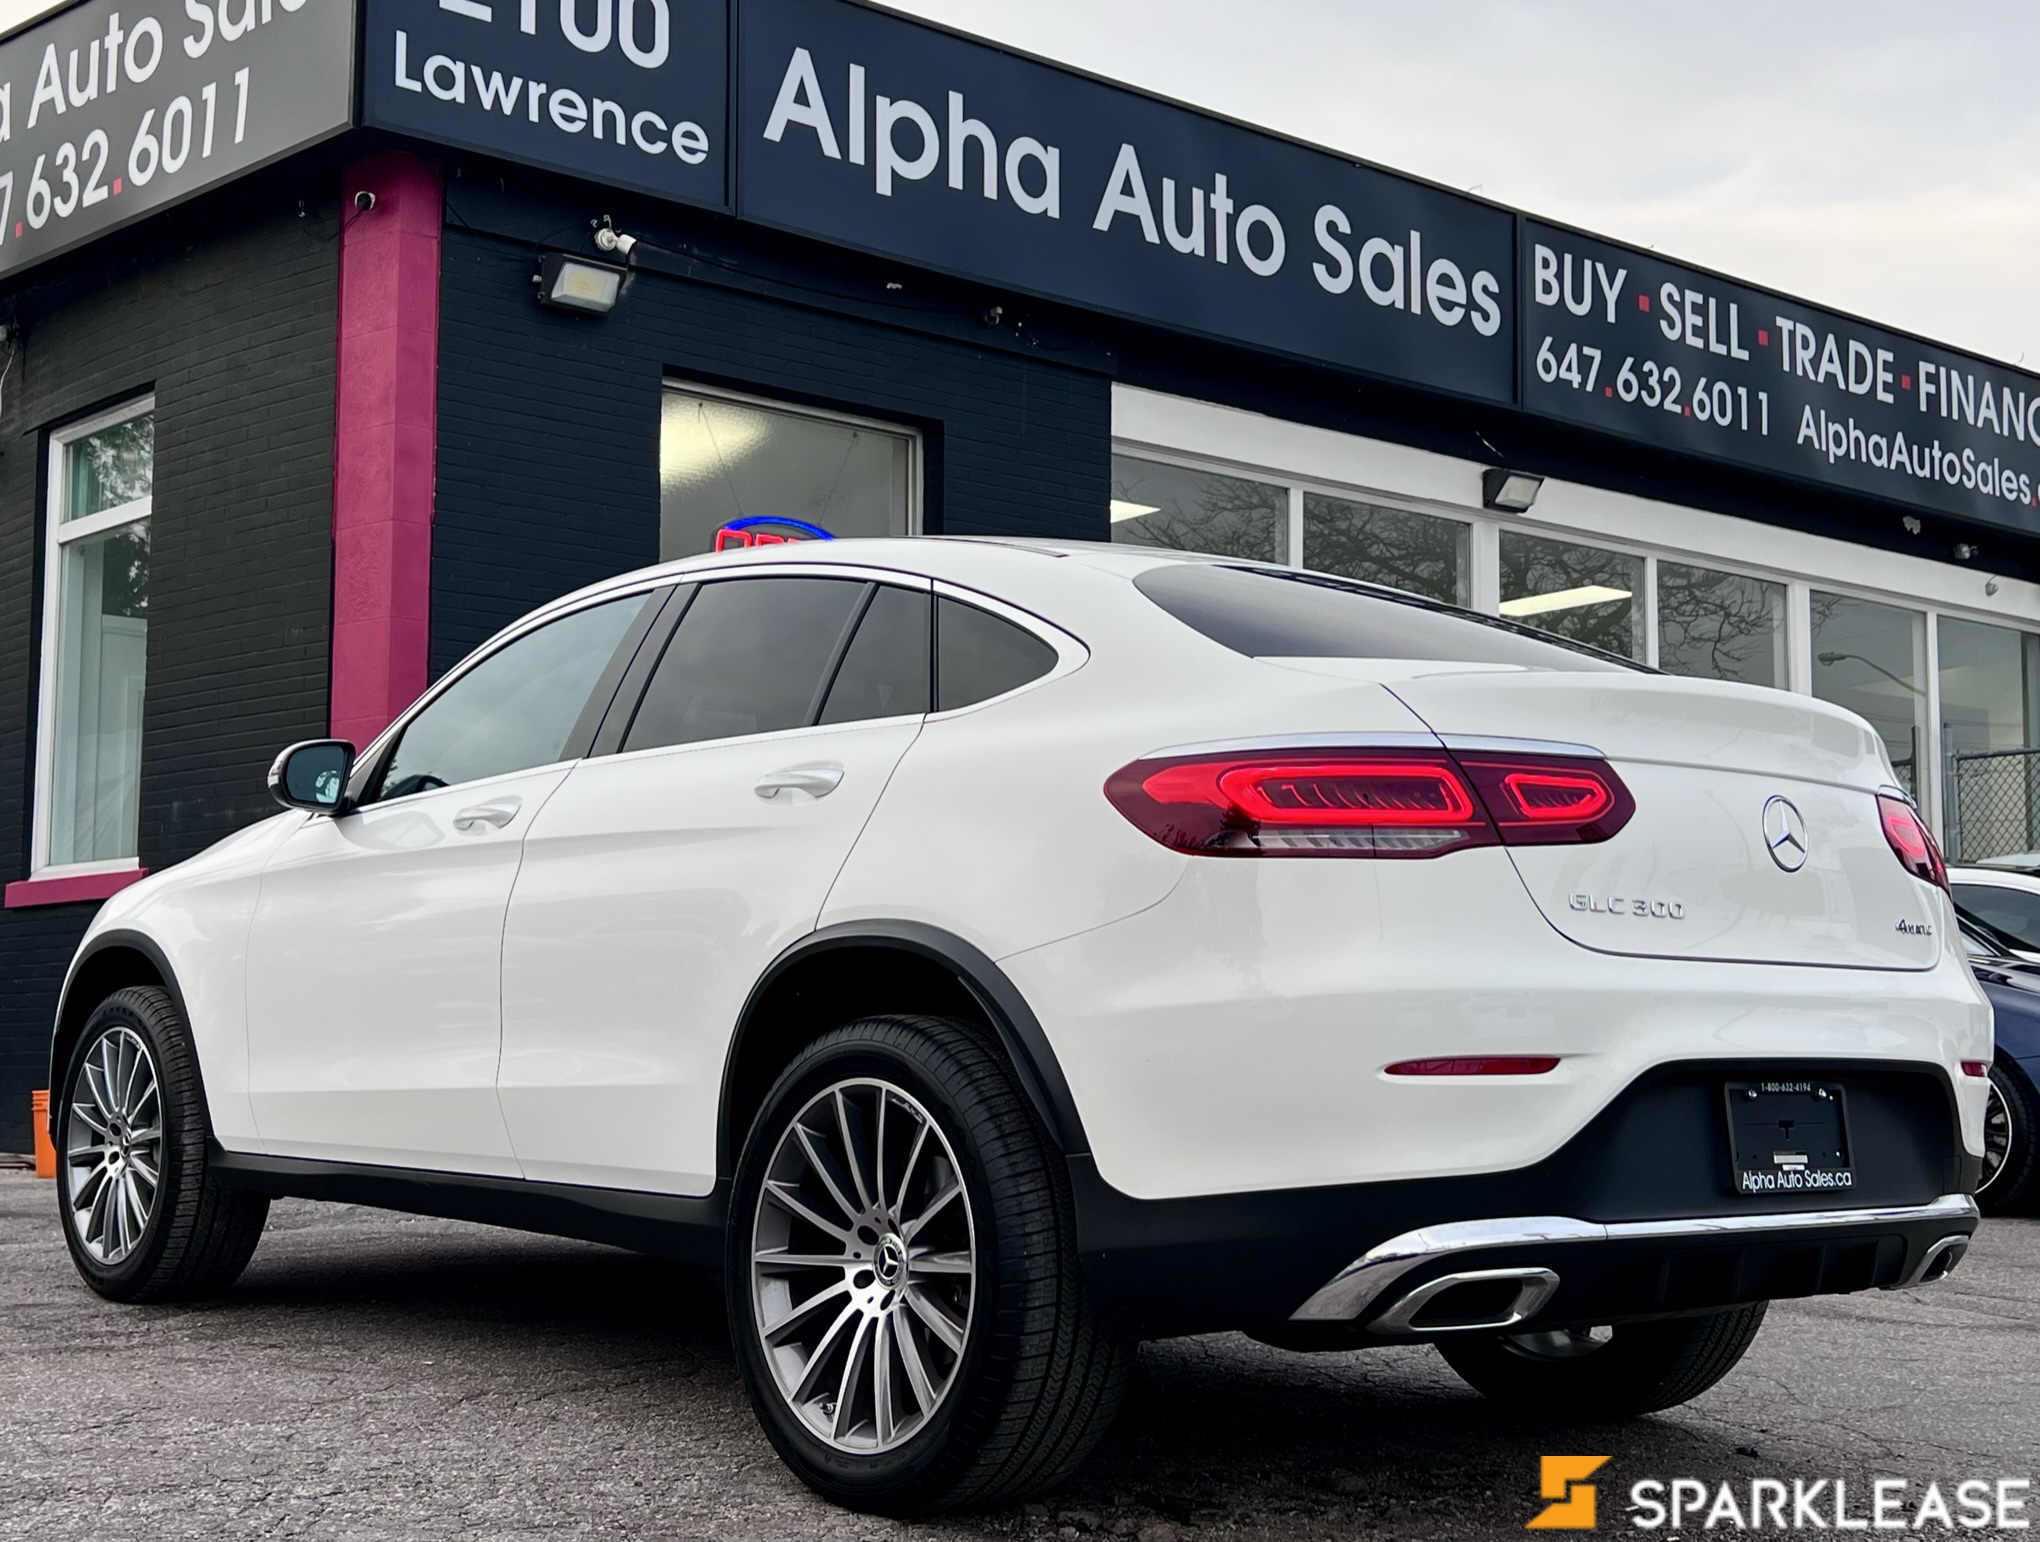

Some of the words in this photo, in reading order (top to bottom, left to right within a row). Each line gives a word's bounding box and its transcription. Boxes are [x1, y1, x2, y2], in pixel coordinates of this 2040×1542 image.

[27, 12, 163, 129] Auto
[395, 30, 709, 164] Lawrence
[763, 46, 1060, 219] Alpha
[1092, 143, 1286, 277] Auto
[1312, 203, 1502, 337] Sales
[1534, 243, 1627, 323] BUY
[1659, 282, 1749, 361] SELL
[1775, 315, 1895, 404] TRADE
[1536, 336, 1769, 436] 647.632.6011
[1797, 404, 2040, 508] AlphaAutoSales.
[1568, 891, 1626, 915] GLC
[1631, 898, 1685, 920] 300
[1742, 1170, 1775, 1193] Alpha
[1777, 1171, 1803, 1189] Auto
[1804, 1169, 1852, 1188] Sales.ca
